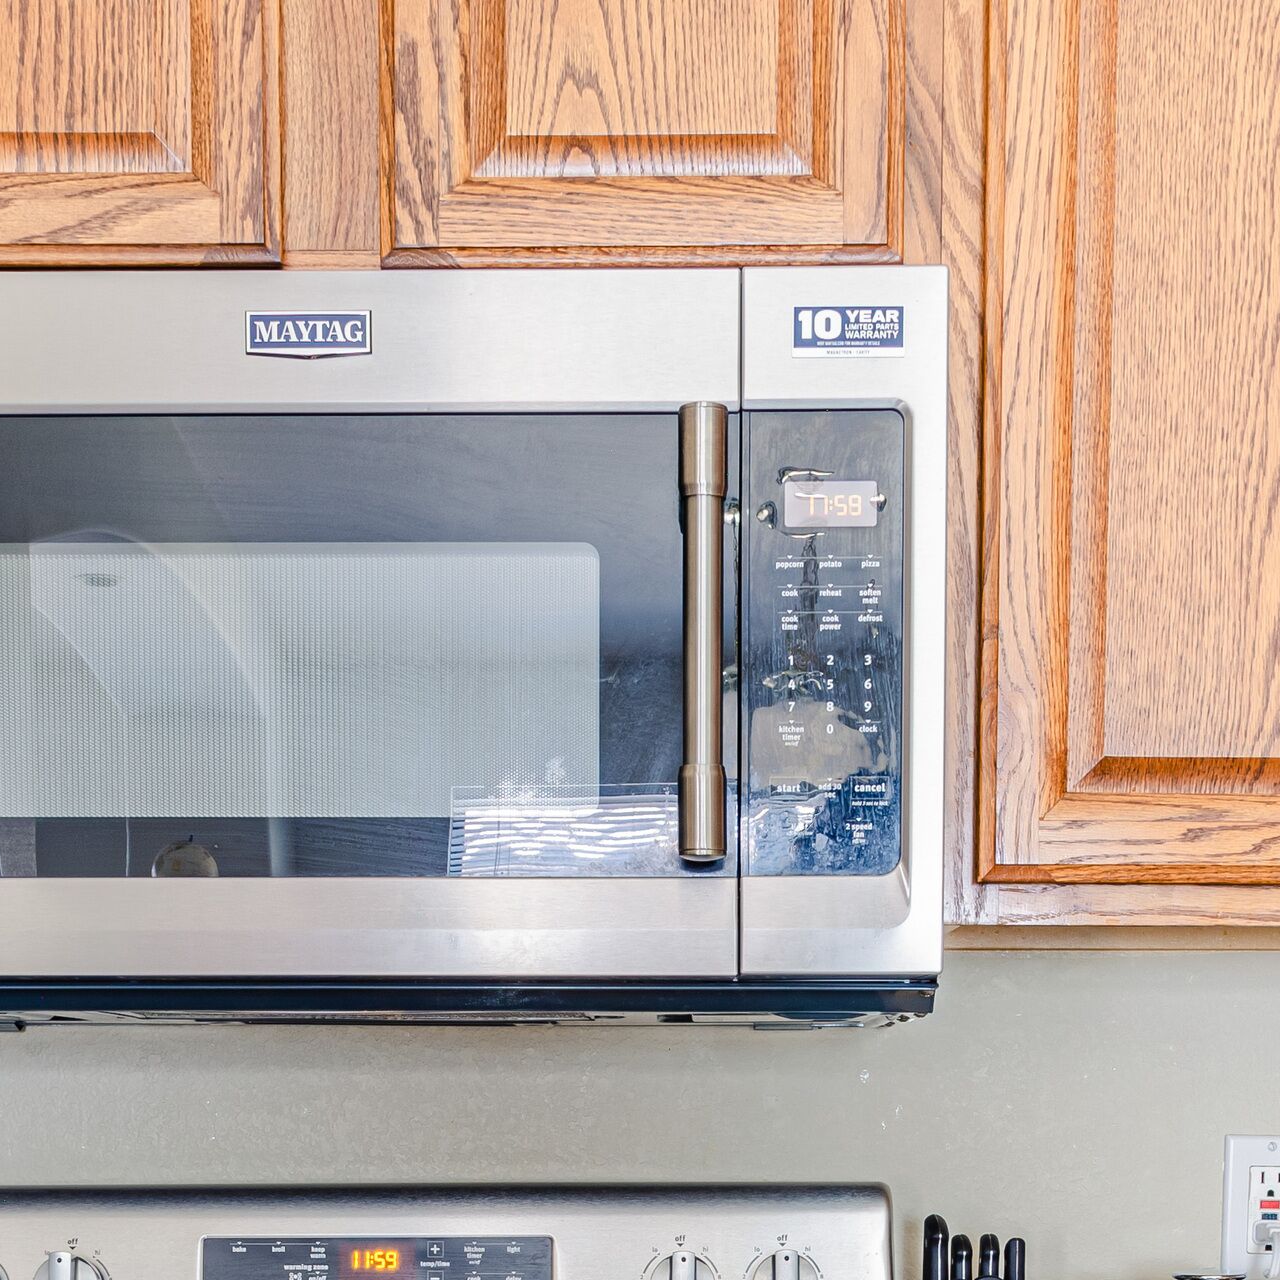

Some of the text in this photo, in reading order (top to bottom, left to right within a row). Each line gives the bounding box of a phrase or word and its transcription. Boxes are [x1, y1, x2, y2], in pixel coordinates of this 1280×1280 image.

[845, 310, 899, 322] YEAR
[798, 309, 842, 340] 10
[845, 323, 899, 331] LIMITED PARTS
[253, 320, 364, 343] MAYTAG
[845, 331, 899, 339] WARRANTY
[776, 561, 804, 569] popcorn
[819, 561, 842, 569] potato
[861, 560, 880, 569] pizza
[781, 589, 798, 597] cook
[819, 589, 842, 597] reheat
[858, 614, 883, 622] defrost
[788, 655, 794, 665] 1
[827, 655, 834, 665] 2
[864, 655, 872, 665] 3
[788, 679, 795, 690] 4
[827, 679, 833, 689] 5
[864, 679, 872, 689] 6
[788, 702, 795, 712] 7
[826, 701, 834, 712] 8
[864, 701, 872, 712] 9
[778, 725, 804, 733] kitchen
[826, 724, 833, 734] 0
[859, 725, 878, 733] clock
[777, 784, 800, 792] start
[854, 782, 886, 792] cancel
[851, 823, 873, 832] speed
[353, 1250, 398, 1269] 11:59
